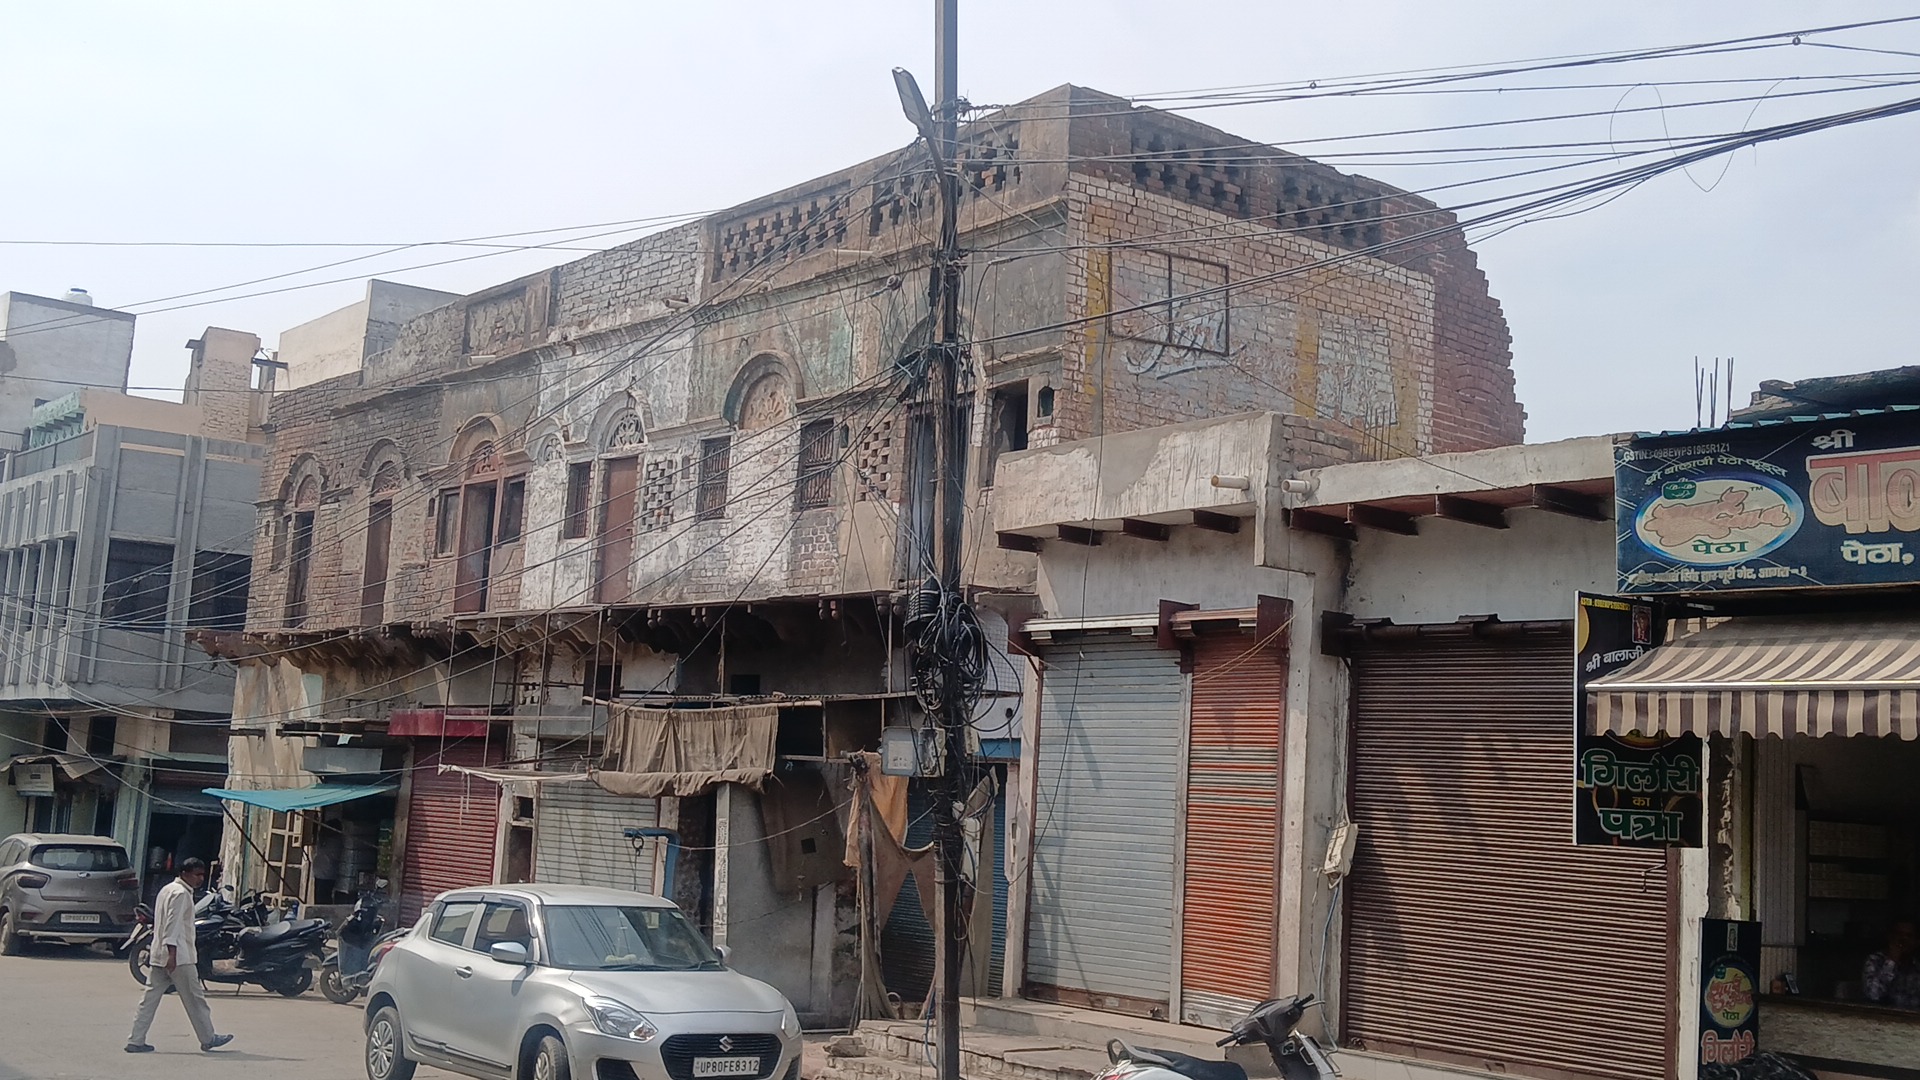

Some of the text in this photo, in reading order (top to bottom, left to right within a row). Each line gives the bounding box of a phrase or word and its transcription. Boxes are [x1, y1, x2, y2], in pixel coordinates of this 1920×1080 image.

[1811, 429, 1856, 450] श्री
[1645, 470, 1662, 485] श्री
[1664, 456, 1715, 475] बालाजी
[1718, 455, 1744, 466] पेठा
[1692, 539, 1750, 555] पेठा
[1585, 645, 1644, 673] श्री बालाजी
[1581, 748, 1701, 793] गिलौरी
[1632, 796, 1651, 807] का
[1722, 1009, 1740, 1021] पेठा
[700, 1059, 760, 1074] UP80FE8312
